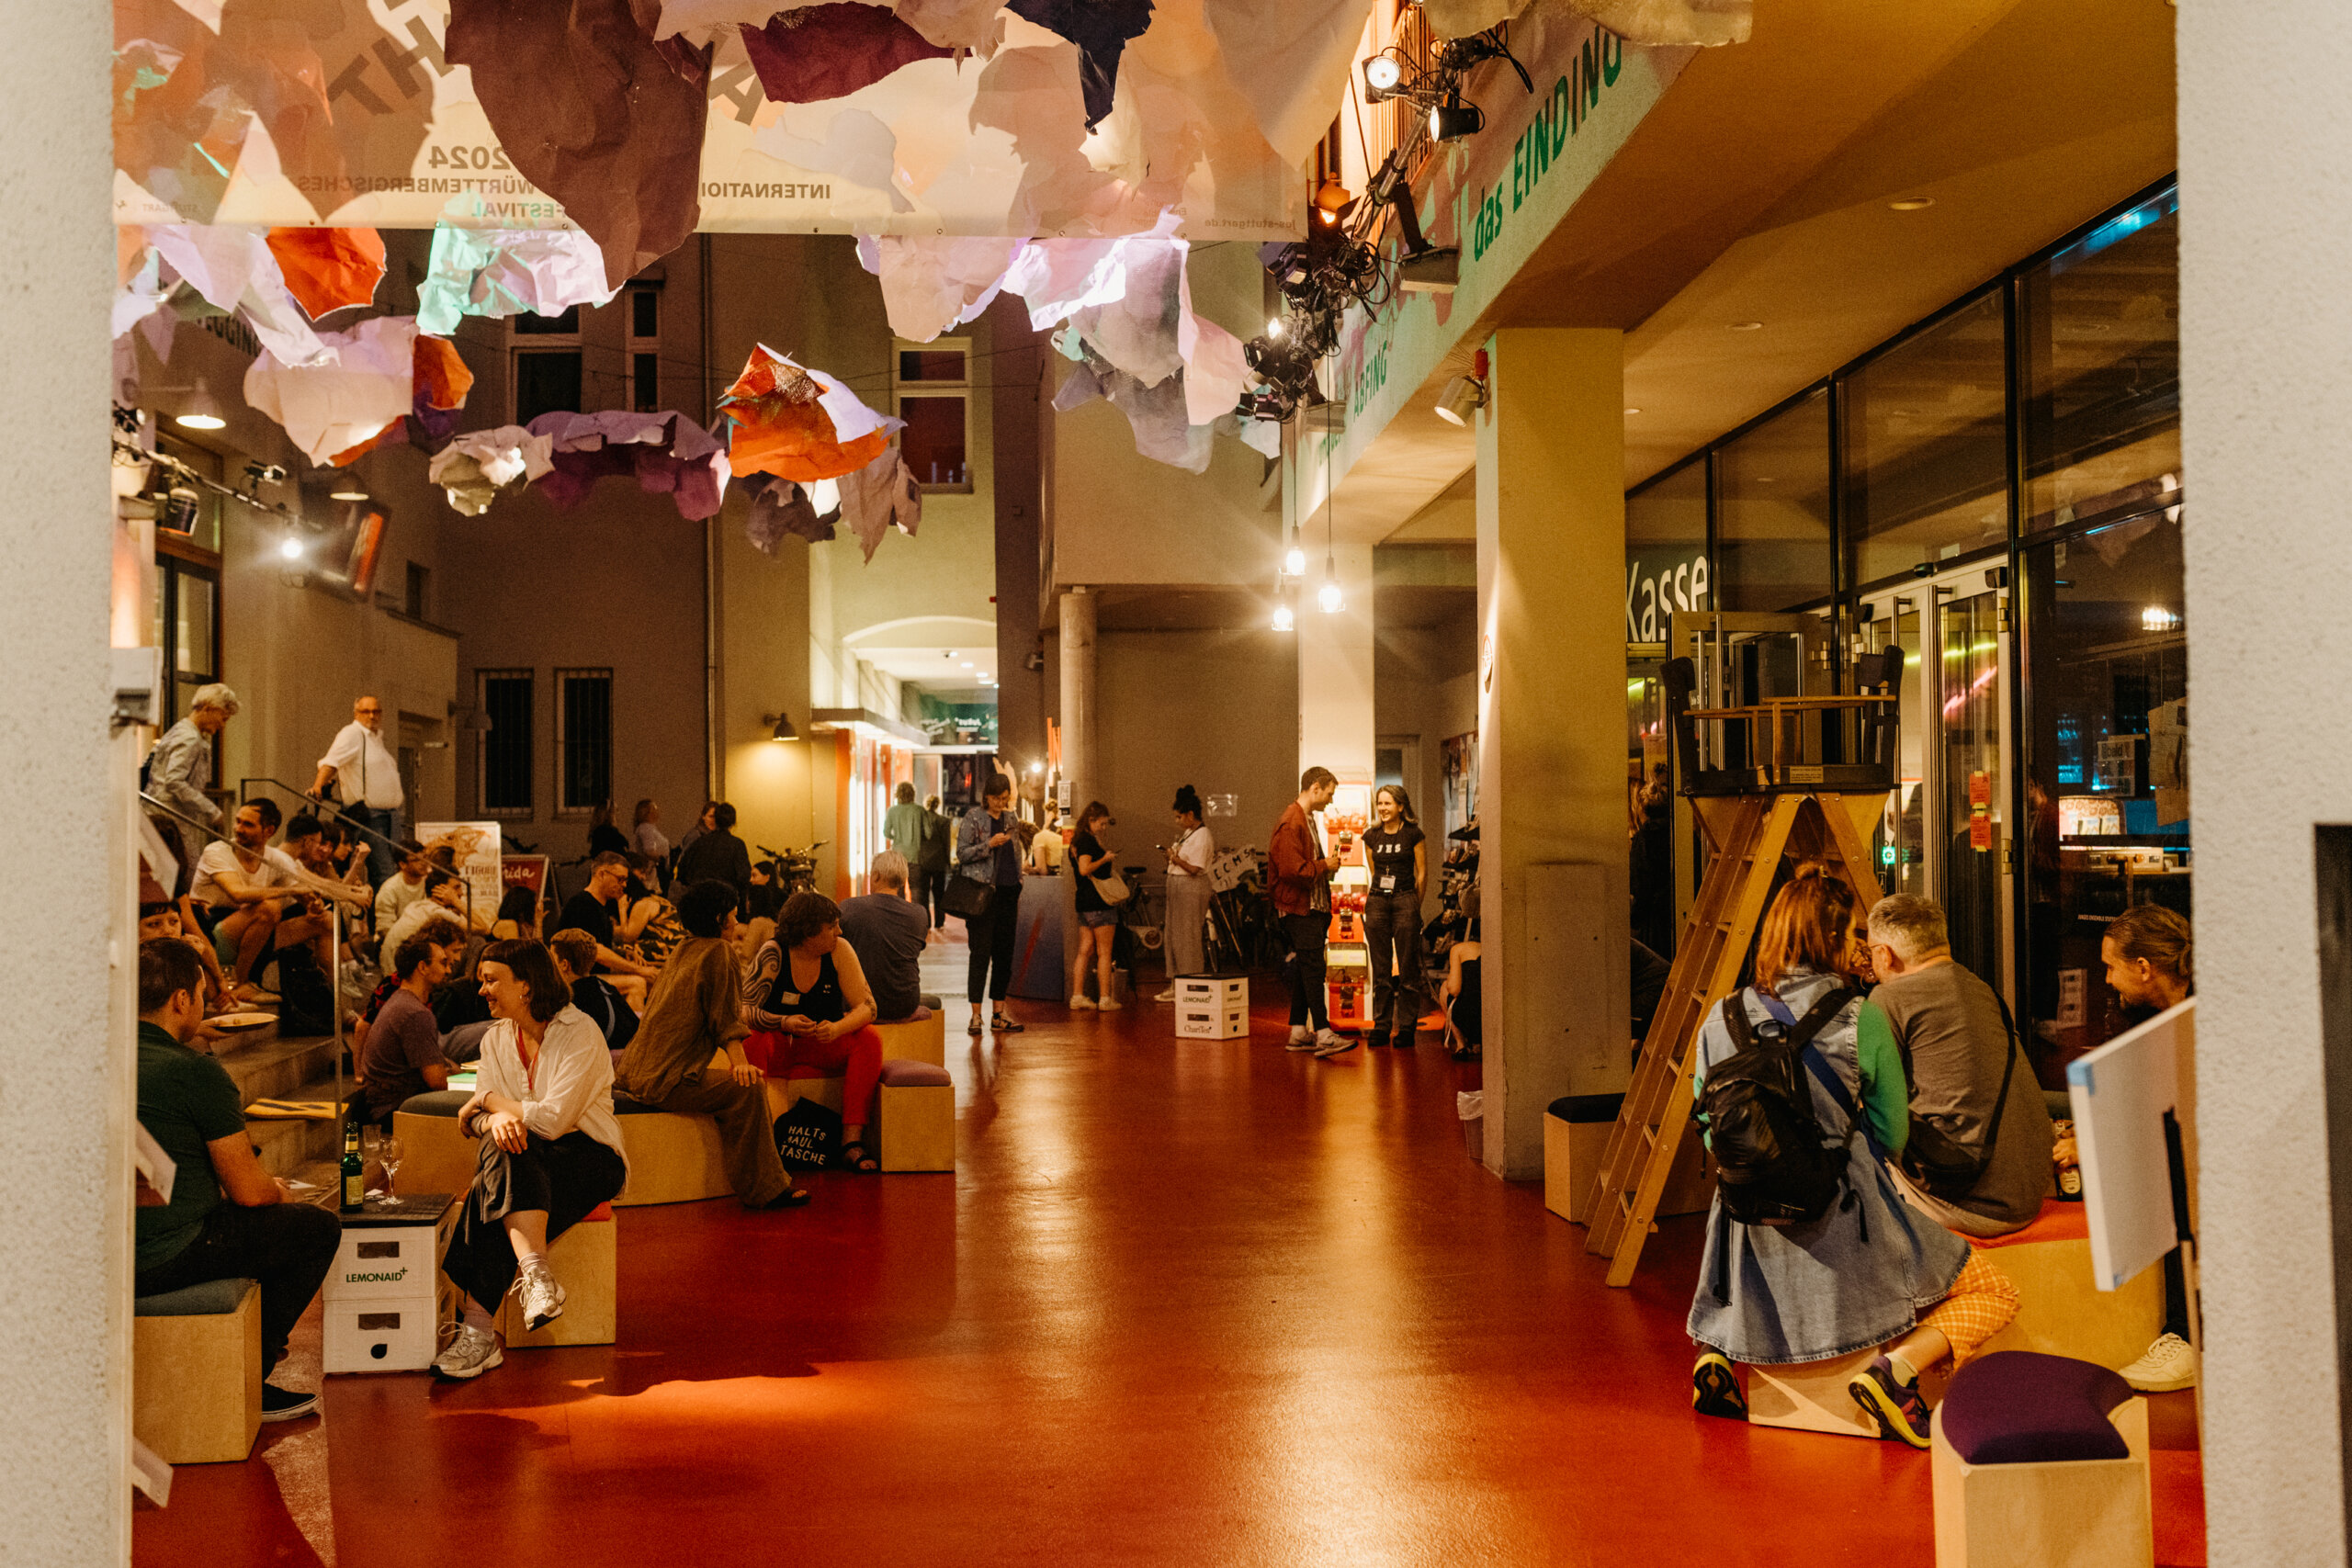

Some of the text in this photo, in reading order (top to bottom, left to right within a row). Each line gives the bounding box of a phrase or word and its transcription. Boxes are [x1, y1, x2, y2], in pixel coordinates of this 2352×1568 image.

[1474, 186, 1502, 262] das
[1625, 556, 1708, 643] Kasse
[780, 1145, 826, 1166] TASCHE
